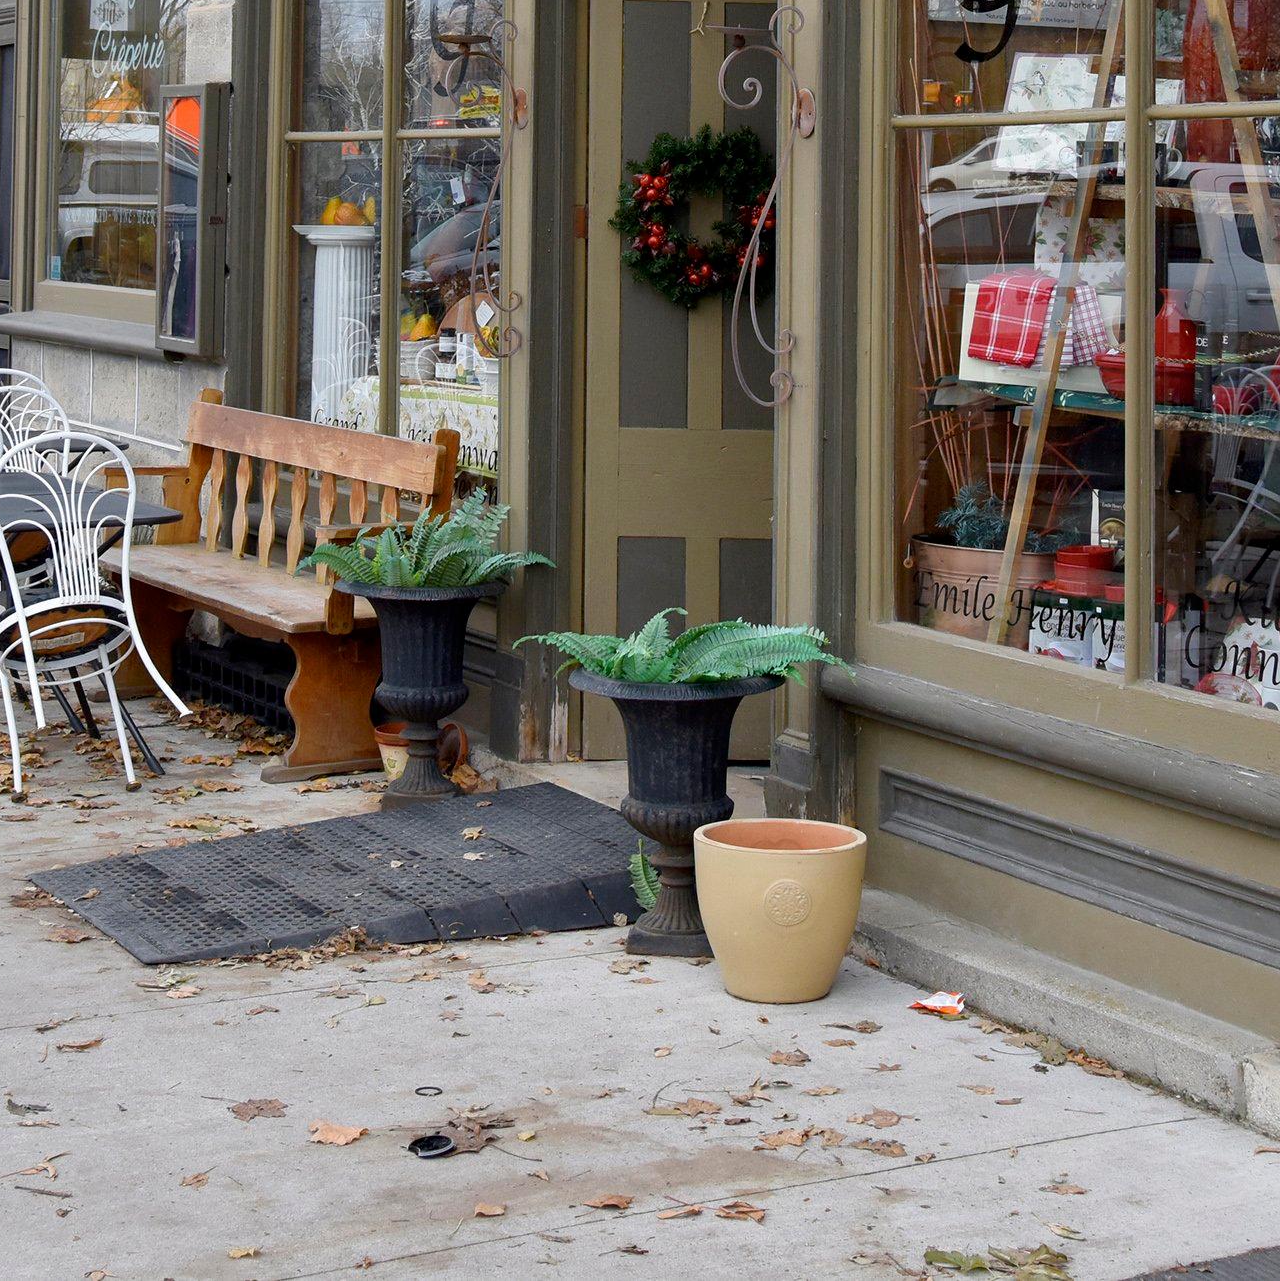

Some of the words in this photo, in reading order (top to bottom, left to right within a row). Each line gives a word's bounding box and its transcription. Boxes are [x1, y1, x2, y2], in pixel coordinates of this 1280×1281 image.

[91, 21, 165, 81] Crêperie
[914, 570, 996, 622] Emile
[1007, 586, 1120, 668] Henry
